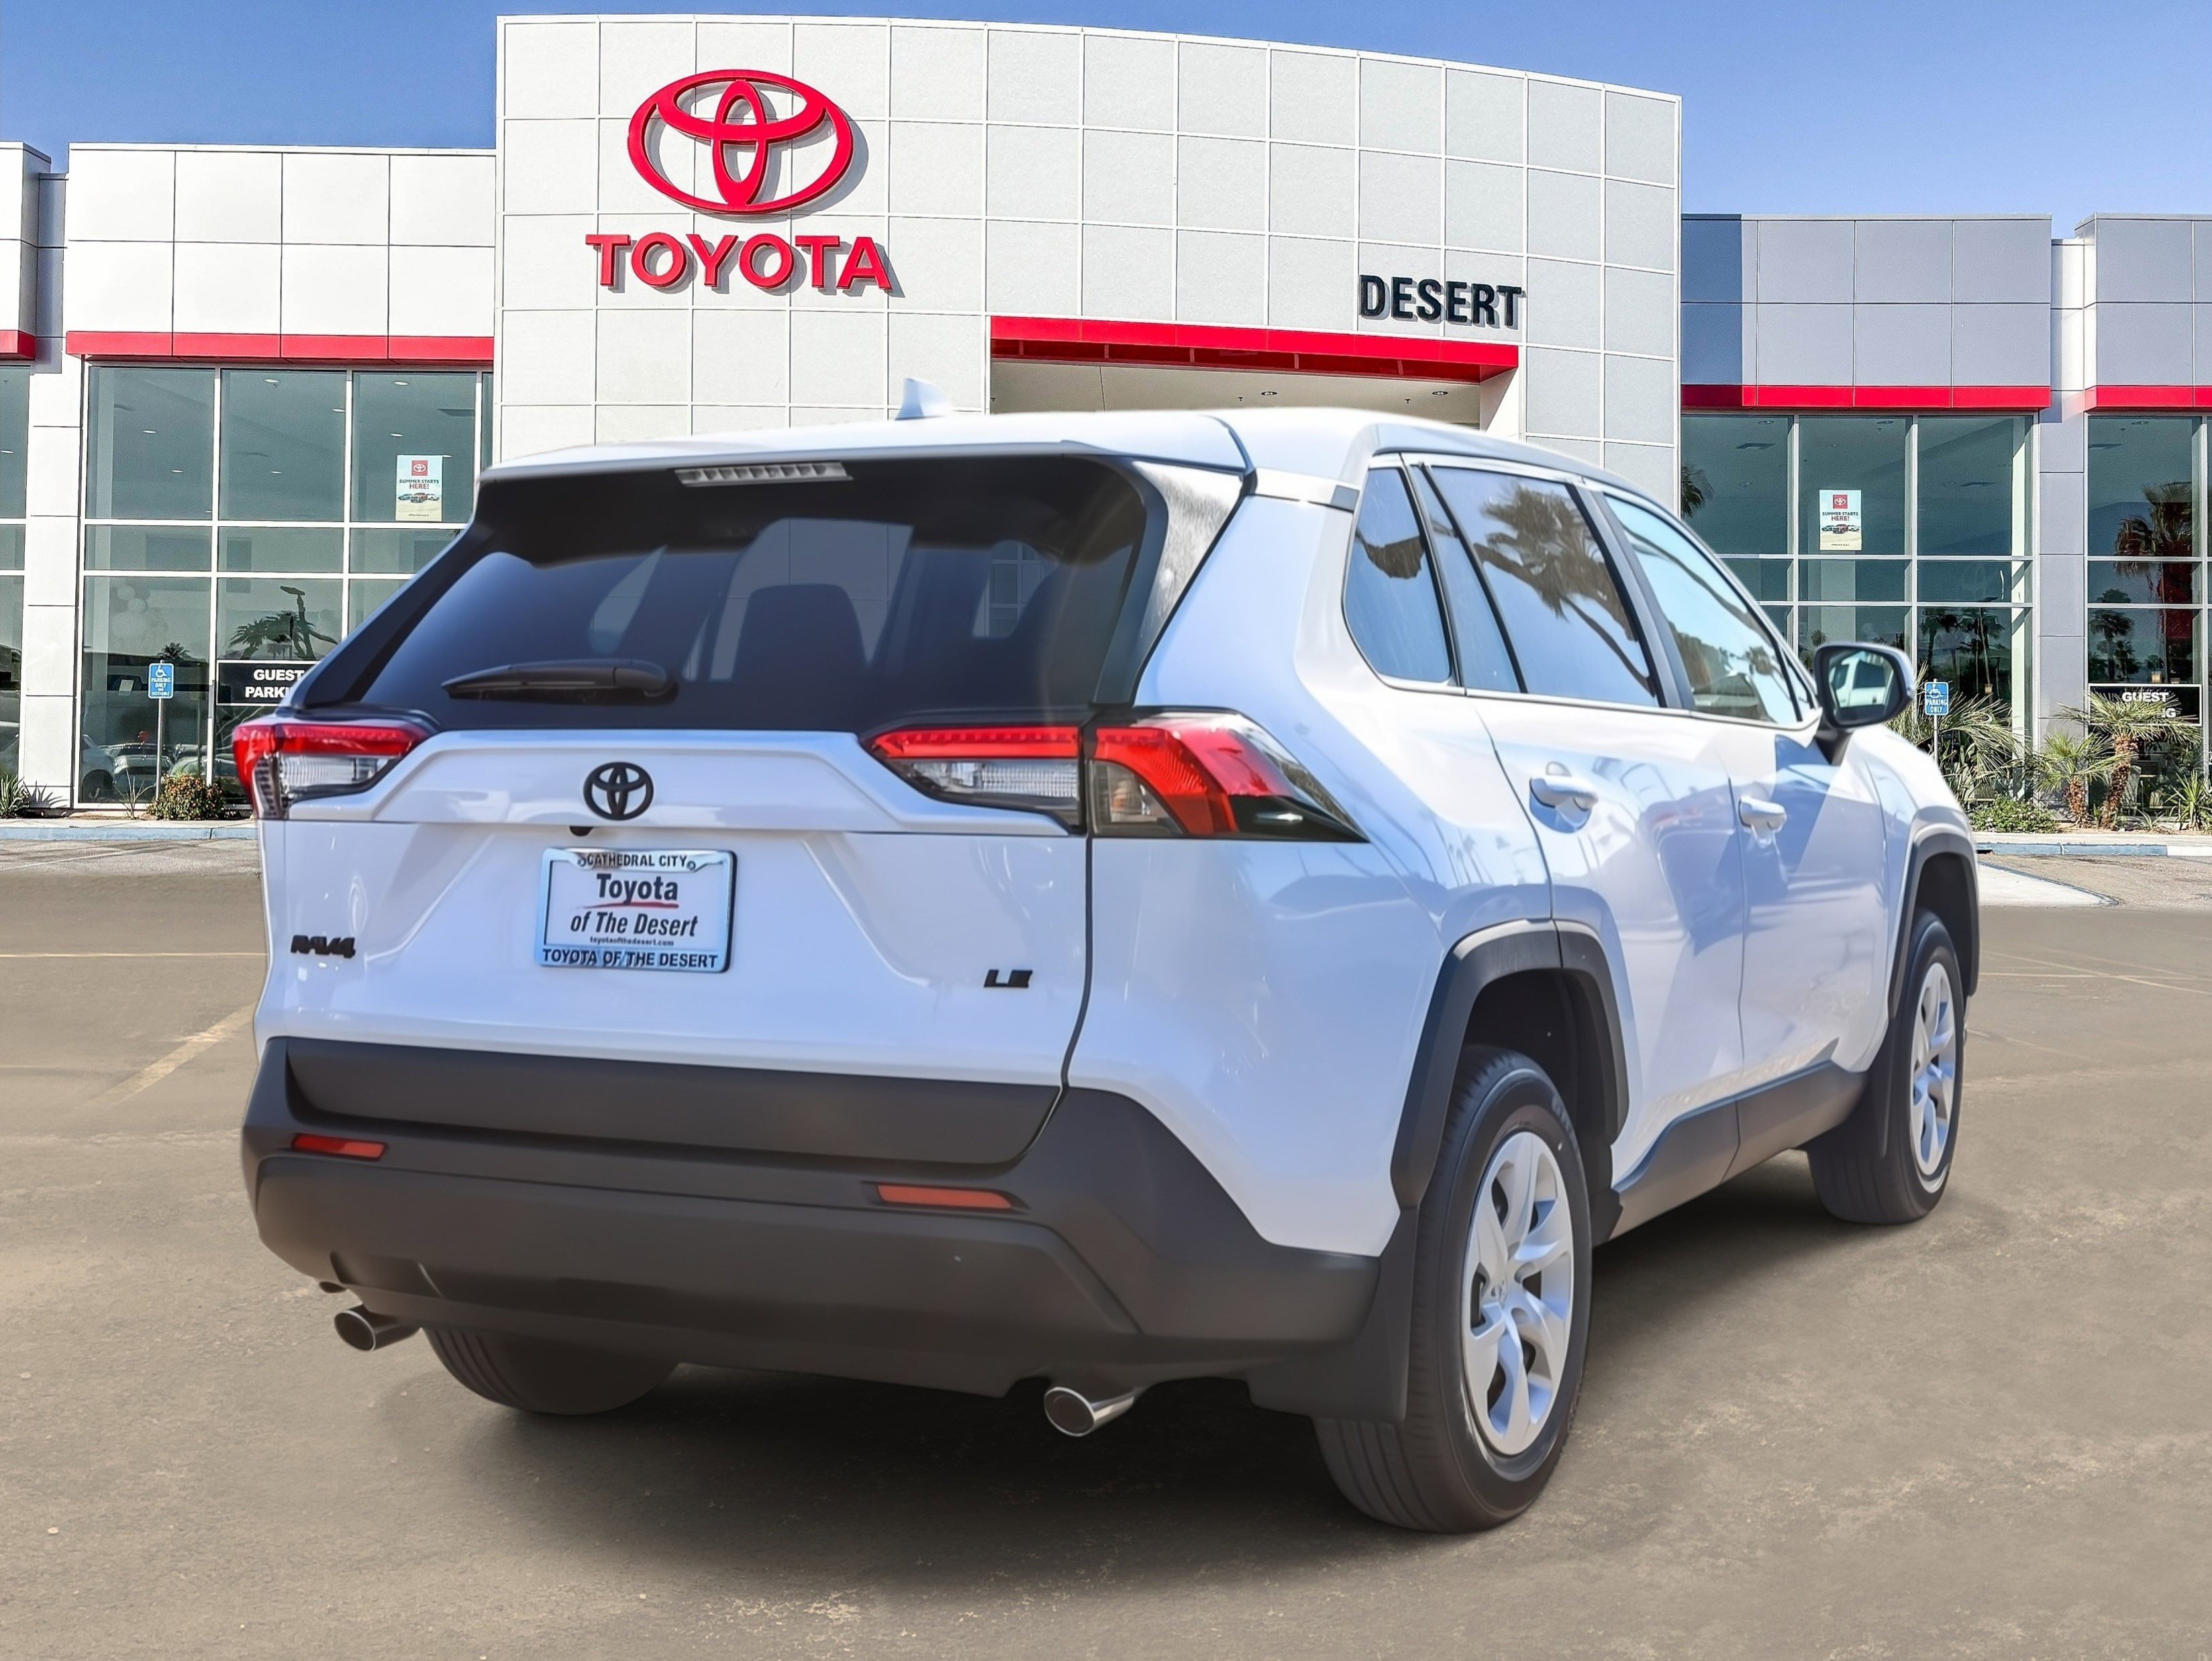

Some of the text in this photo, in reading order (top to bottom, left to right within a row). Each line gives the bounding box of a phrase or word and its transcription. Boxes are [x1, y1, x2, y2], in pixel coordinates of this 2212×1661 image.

[585, 232, 893, 291] TOYOTA
[1359, 274, 1522, 327] DESERT
[254, 669, 305, 681] GUEST
[2121, 692, 2169, 703] GUEST
[587, 854, 687, 867] CATHEDRAL CITY
[597, 873, 678, 905] Toyota
[570, 911, 698, 937] of The Desert
[590, 936, 674, 946] toyotaofthedesert.com
[543, 948, 717, 968] TOYOTA OF THE DESERT
